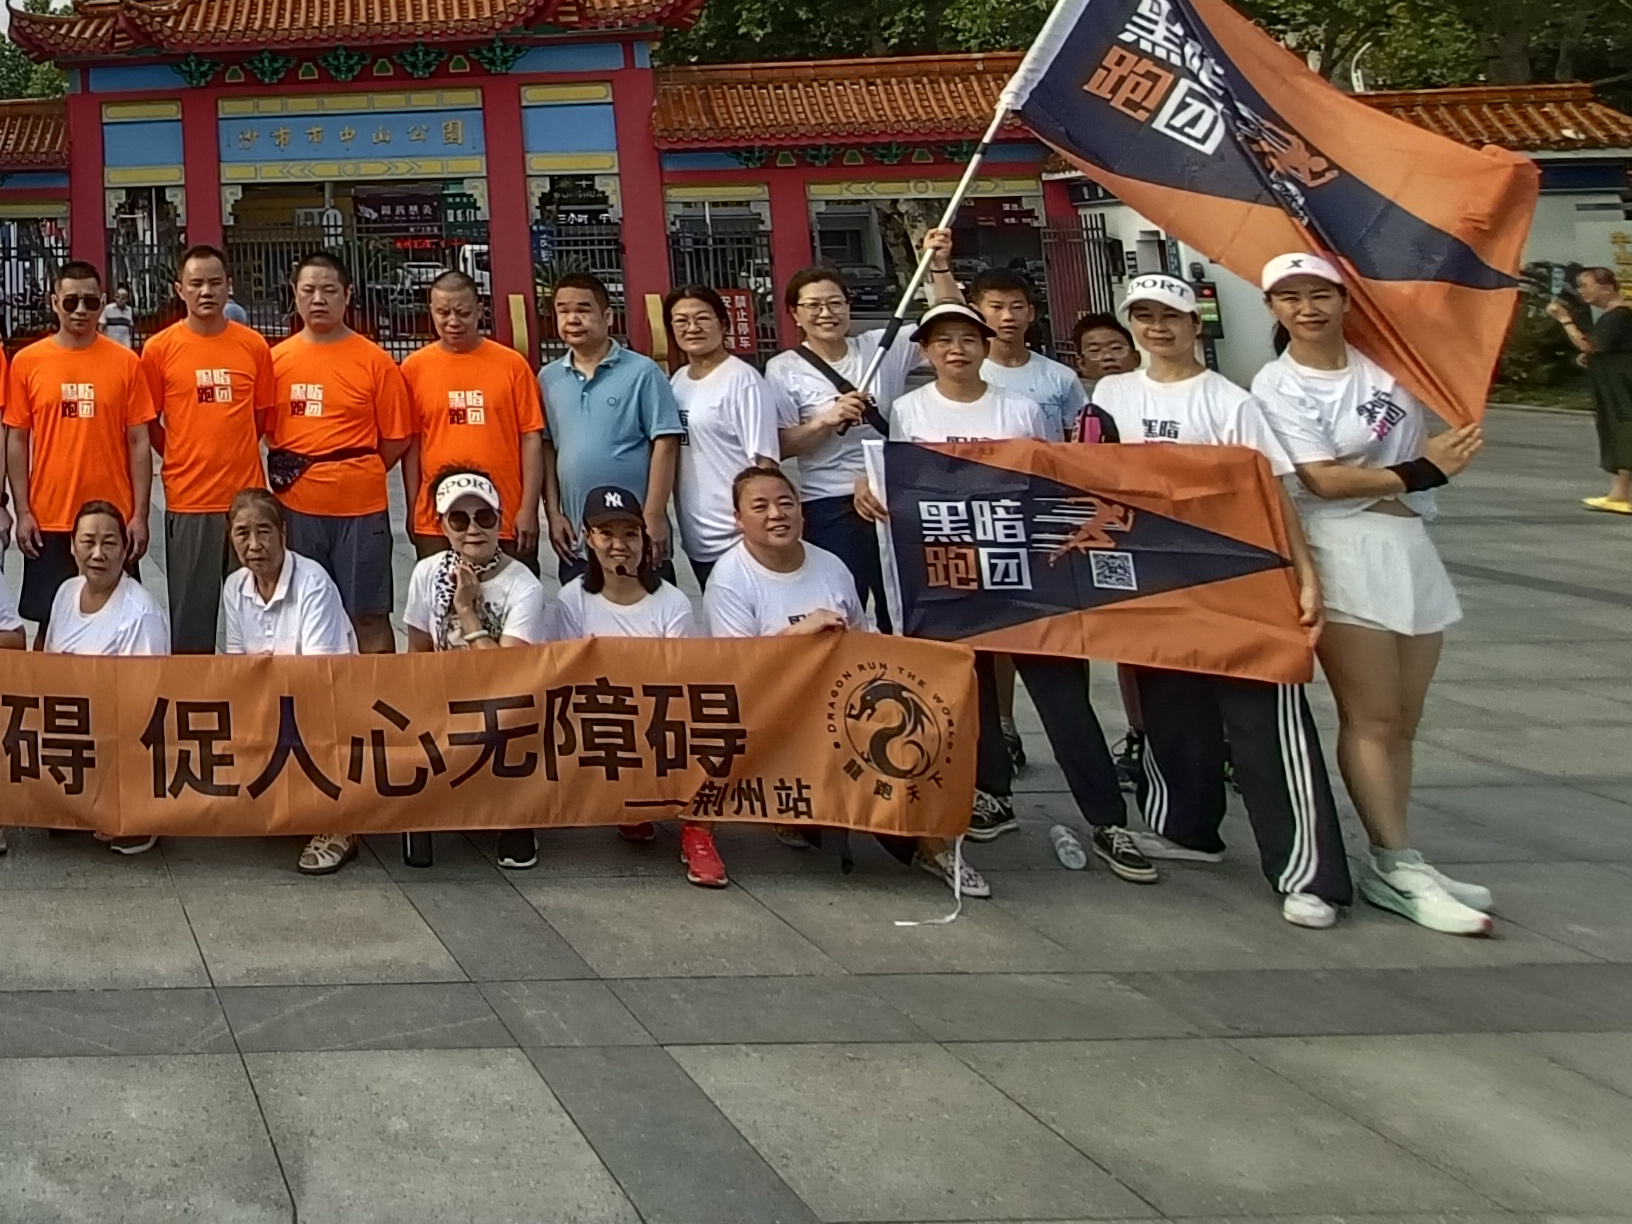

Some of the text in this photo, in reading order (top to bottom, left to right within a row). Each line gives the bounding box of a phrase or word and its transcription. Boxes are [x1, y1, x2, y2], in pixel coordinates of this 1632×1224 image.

[1082, 45, 1226, 156] 跑团
[735, 295, 751, 349] 禁止停车
[62, 384, 94, 400] 黑暗
[196, 369, 231, 387] 黑暗
[290, 383, 323, 400] 黑暗
[448, 390, 484, 408] 黑暗
[1142, 418, 1180, 439] 黑暗
[437, 478, 493, 502] SPORT
[919, 499, 1027, 544] 黑暗
[924, 545, 1033, 591] 跑团
[827, 670, 853, 733] DRAGON
[857, 661, 888, 672] RUN
[897, 666, 927, 689] THE
[139, 677, 748, 802] 促人心无障碍
